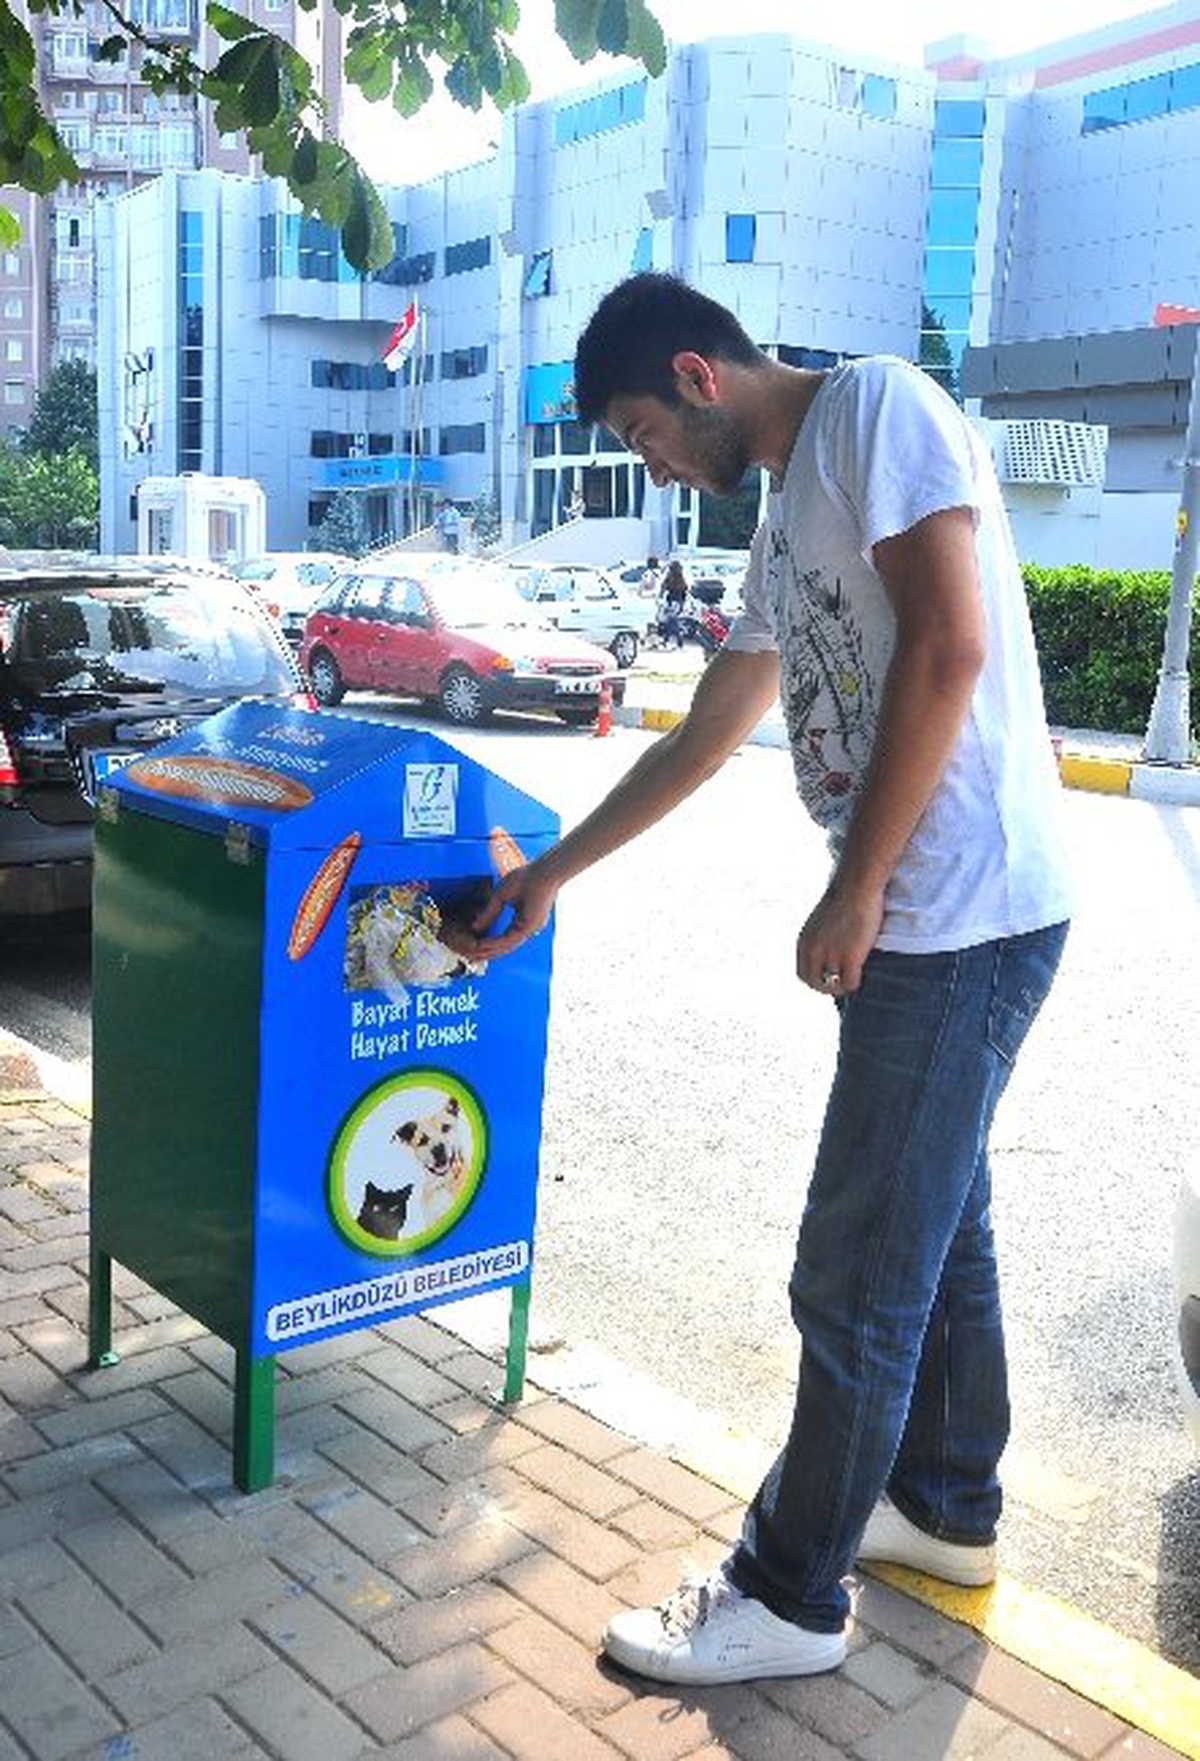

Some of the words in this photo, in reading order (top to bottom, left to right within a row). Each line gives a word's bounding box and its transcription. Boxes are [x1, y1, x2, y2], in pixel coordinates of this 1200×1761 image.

[352, 998, 411, 1028] Bayat
[416, 985, 480, 1018] Ekmek
[351, 1029, 410, 1060] Hayat
[416, 1017, 478, 1050] Demek
[275, 1275, 407, 1332] BEYLİKDÜZÜ
[413, 1246, 523, 1294] BELEDİYESİ
